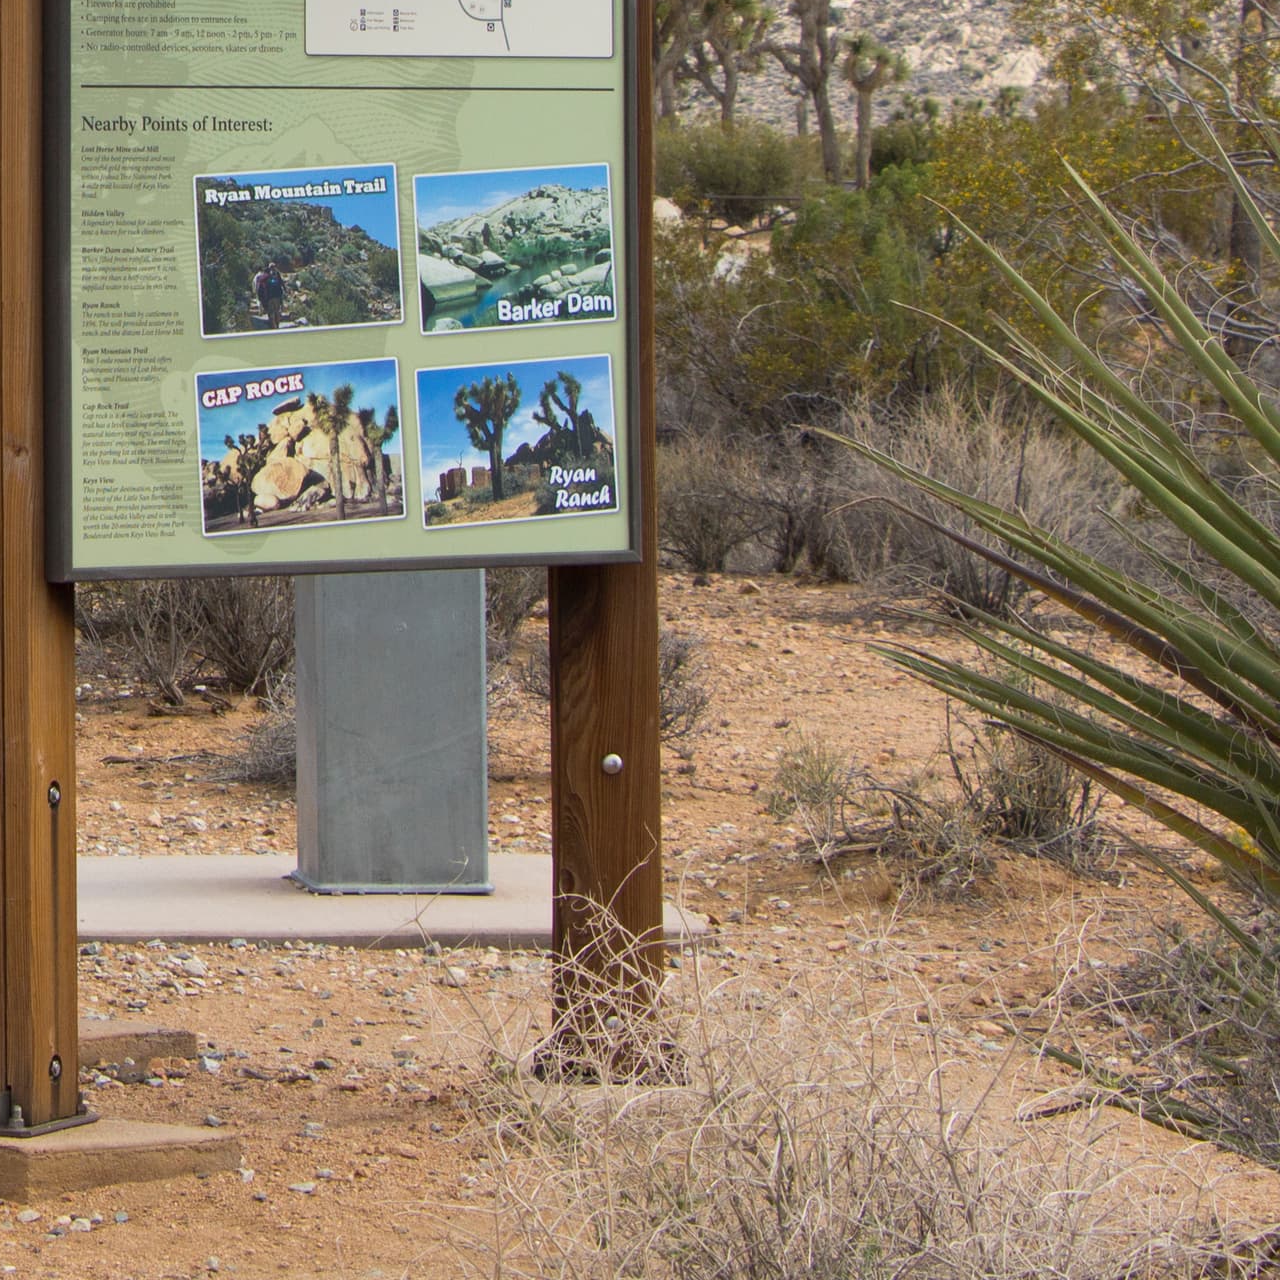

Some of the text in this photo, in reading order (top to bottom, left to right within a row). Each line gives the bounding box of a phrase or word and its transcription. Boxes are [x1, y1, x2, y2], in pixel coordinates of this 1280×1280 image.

[82, 114, 273, 136] Nearby Points of Interest:
[204, 177, 386, 206] Ryan Mountain Trail
[497, 293, 612, 322] Barker Dam
[201, 373, 304, 408] CAP ROCK
[550, 465, 596, 488] Ryan
[554, 485, 611, 508] Ranch
